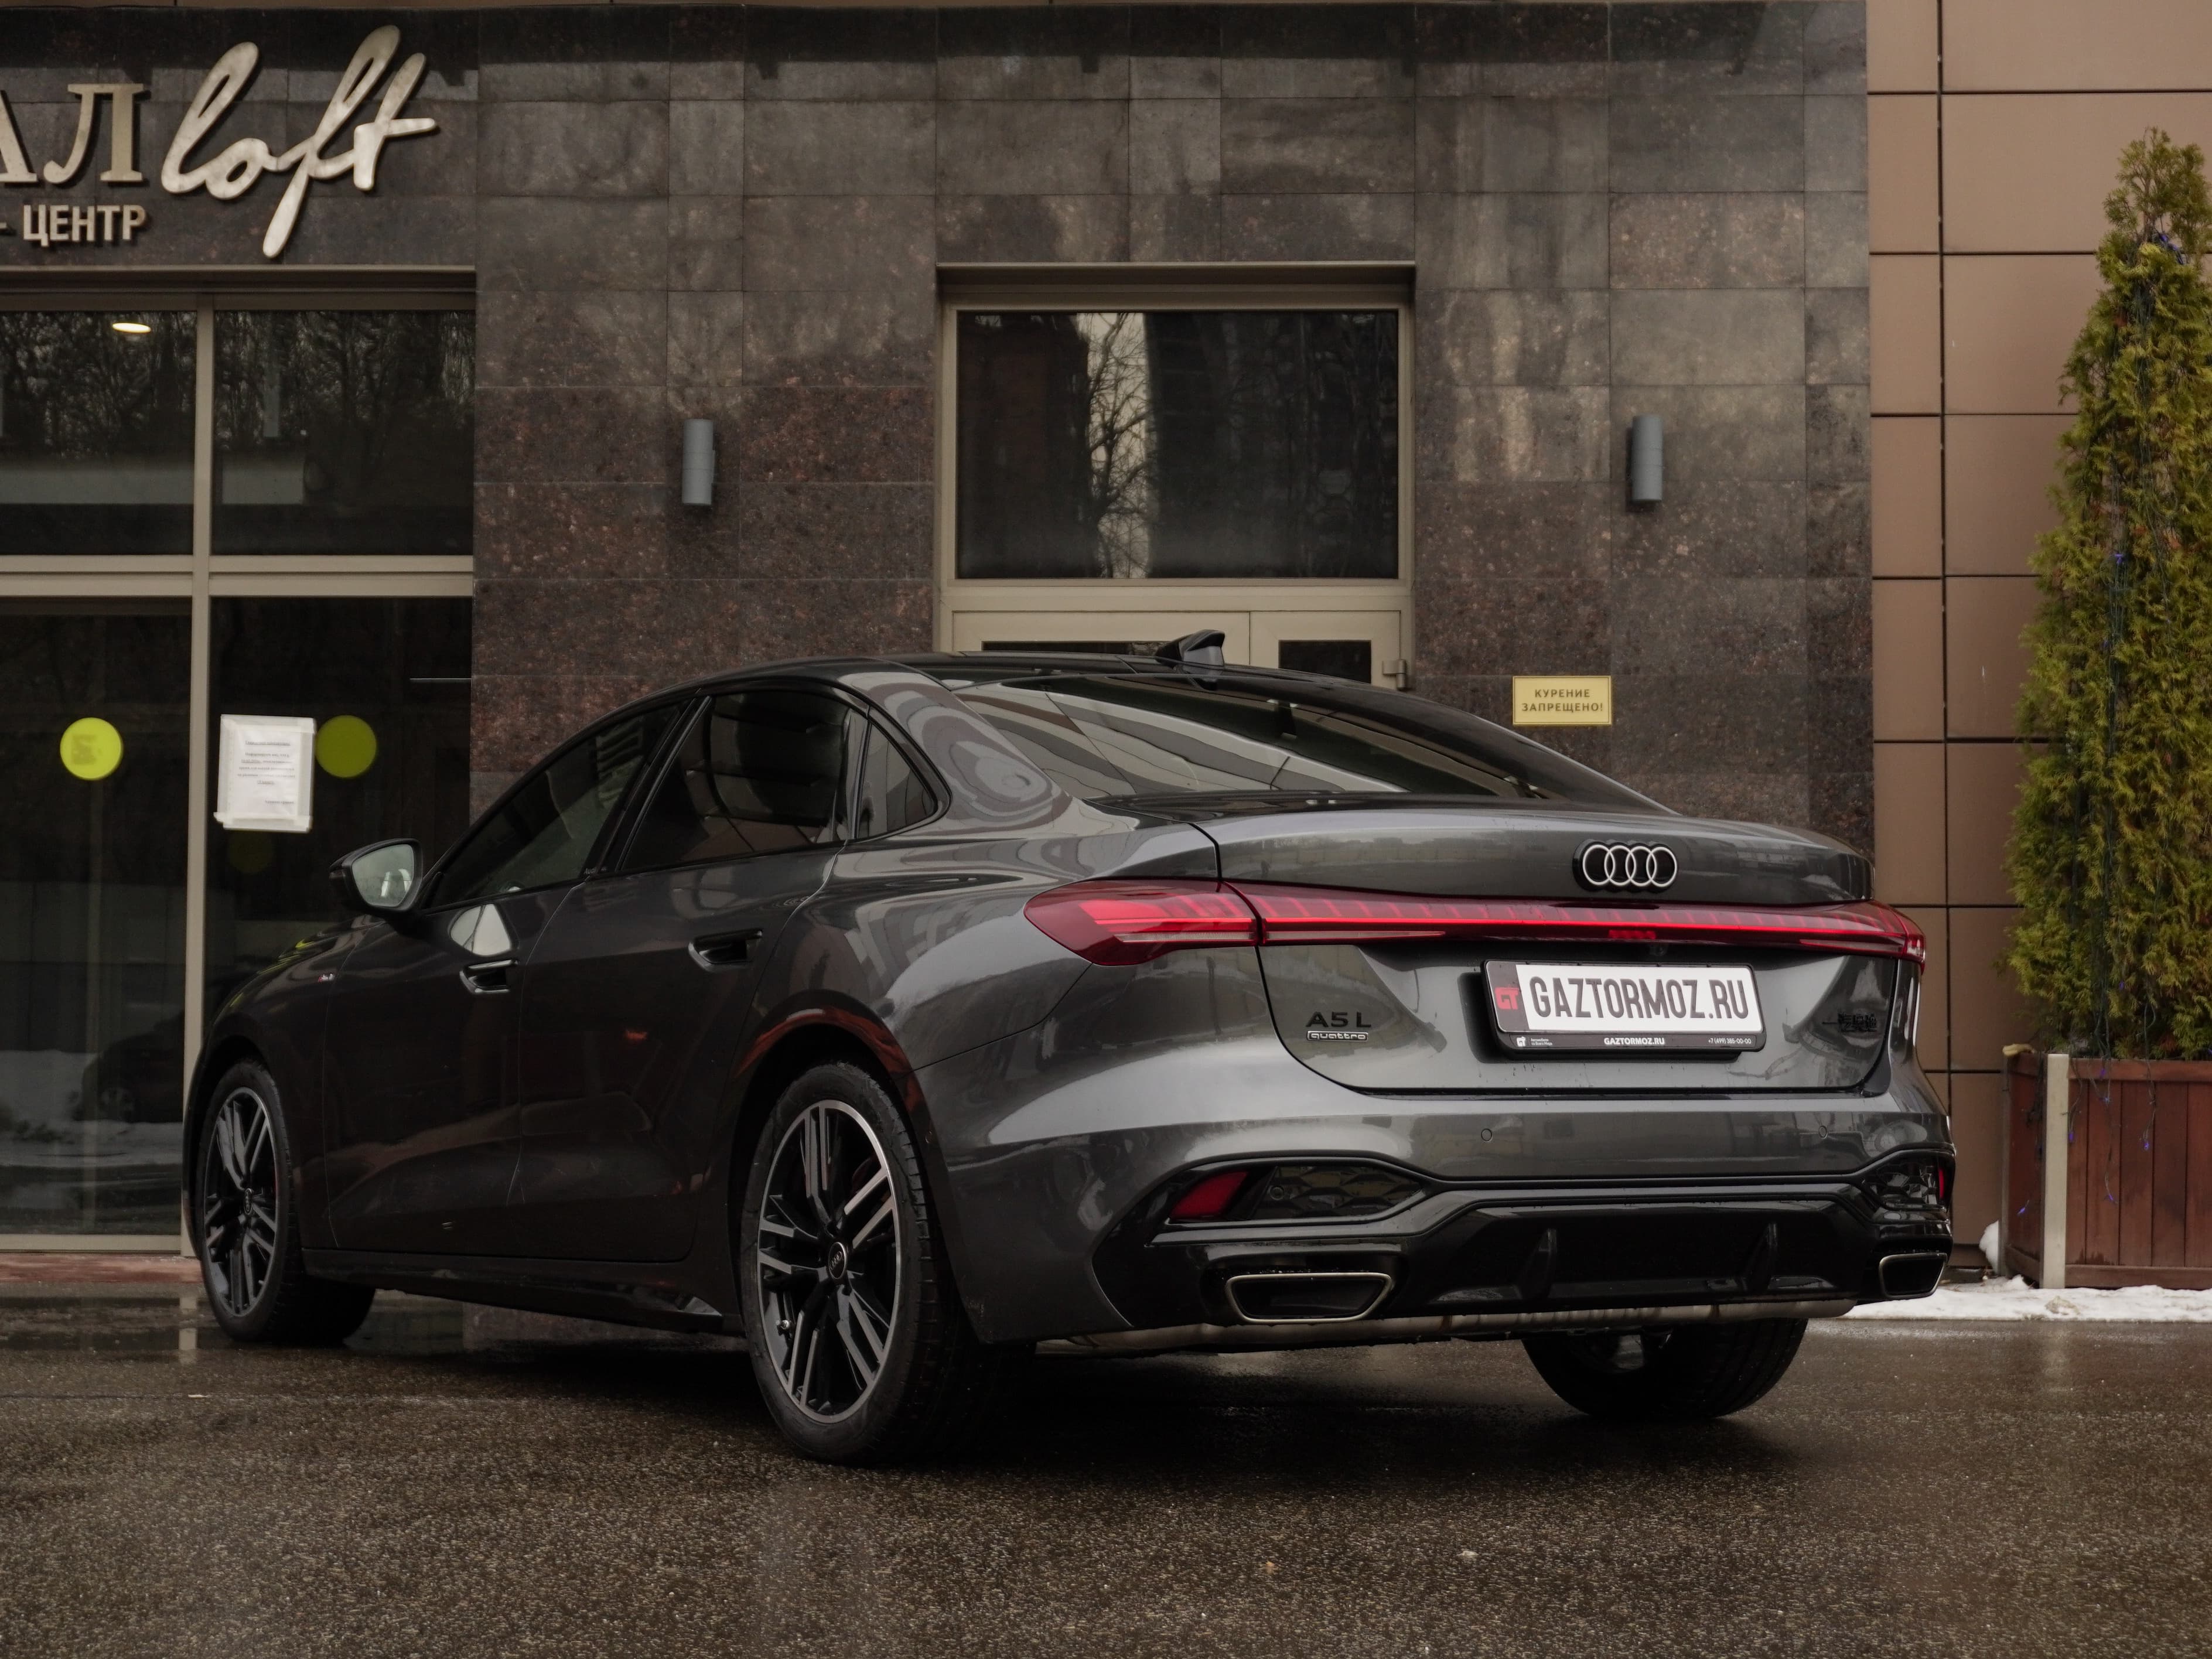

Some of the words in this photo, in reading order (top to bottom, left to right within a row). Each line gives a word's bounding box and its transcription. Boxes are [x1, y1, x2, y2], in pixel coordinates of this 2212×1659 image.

[161, 25, 436, 258] loft
[23, 204, 146, 247] ЦЕНТР
[1534, 689, 1591, 698] КУРЕНИЕ
[1521, 702, 1603, 712] ЗАПРЕЩЕНО!
[1529, 976, 1749, 1020] GAZTORMOZ.RU
[1305, 1011, 1349, 1028] A5
[1356, 1011, 1371, 1028] L
[1603, 1037, 1665, 1045] GAZTORMOZ.RU
